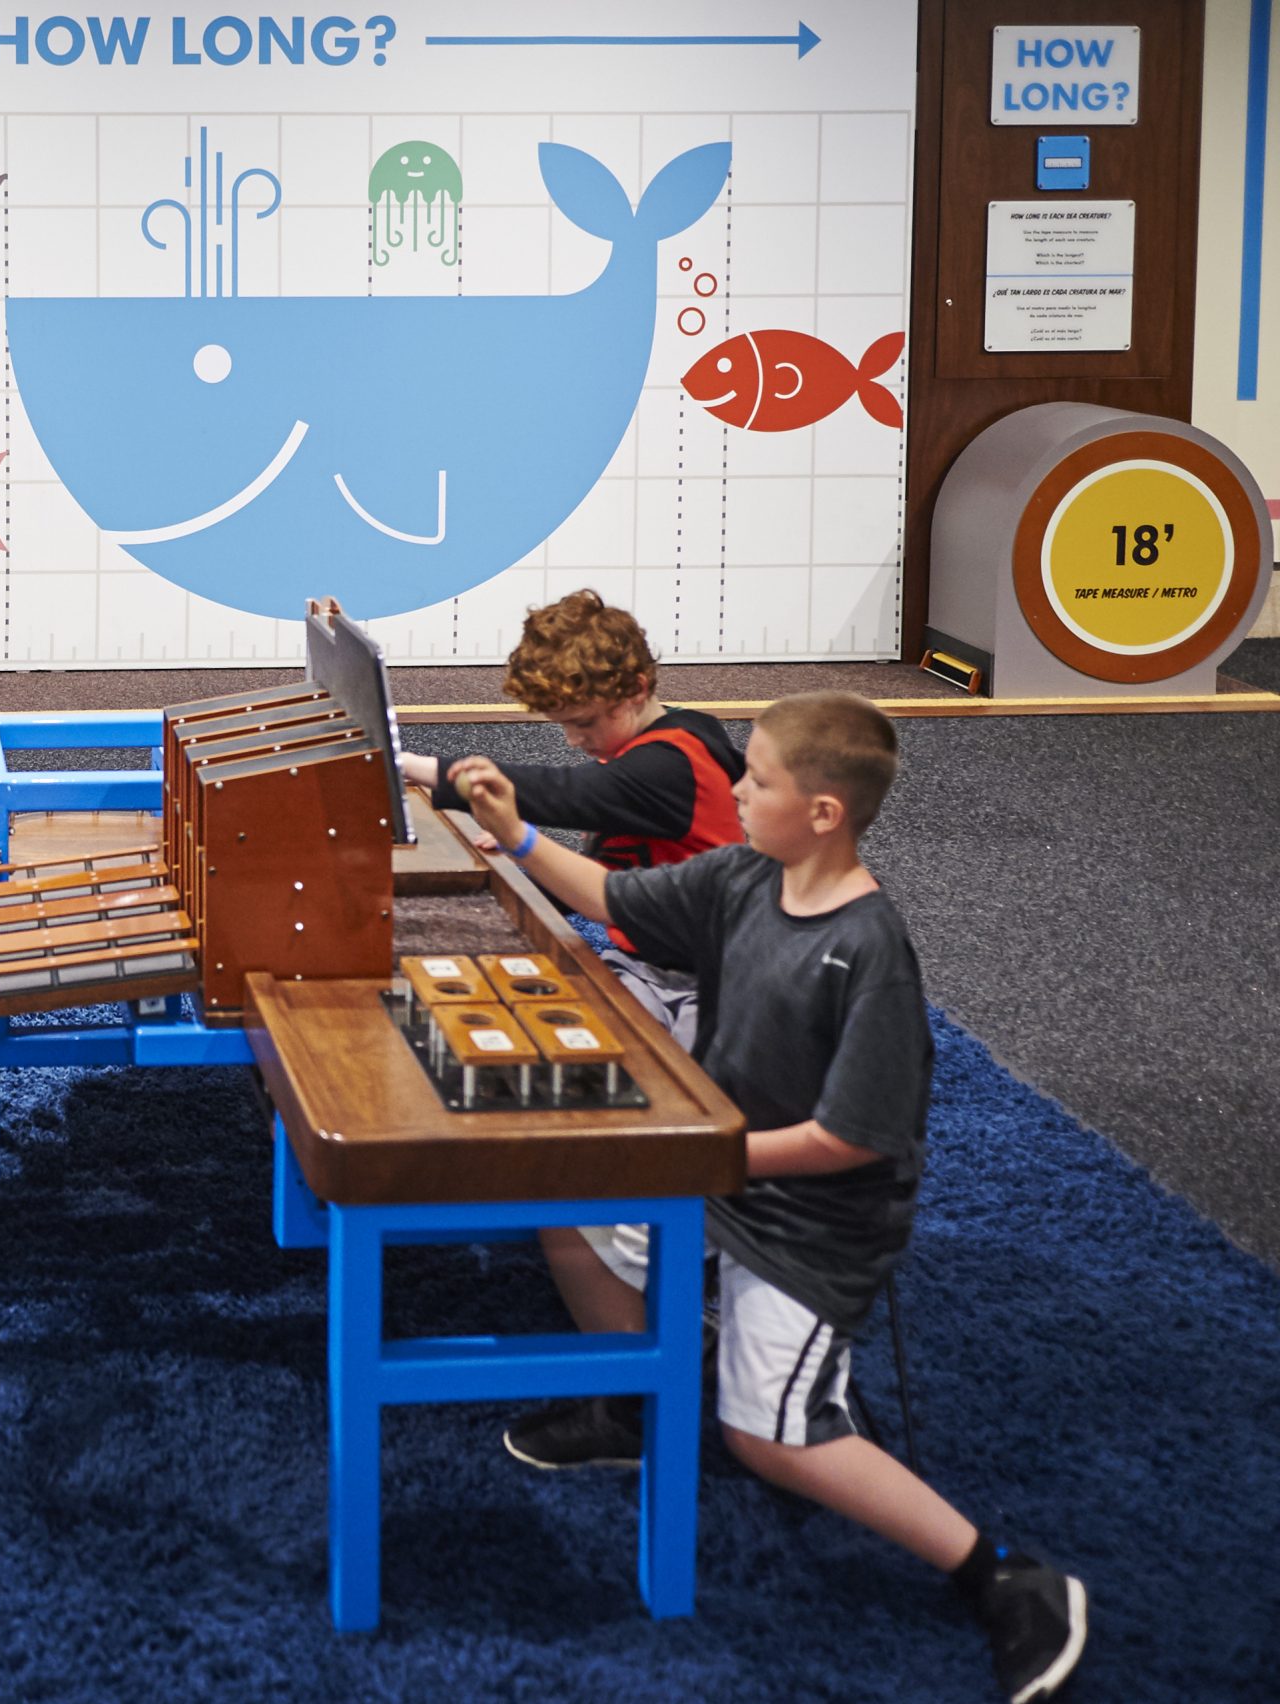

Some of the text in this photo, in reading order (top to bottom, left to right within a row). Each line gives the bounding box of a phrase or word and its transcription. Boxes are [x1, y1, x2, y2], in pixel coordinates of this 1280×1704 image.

[172, 14, 396, 67] LONG?
[1017, 38, 1114, 69] HOW
[1004, 81, 1130, 112] LONG?
[1010, 211, 1112, 221] HOW LONG IS EACH SEA CREATURE?
[992, 287, 1126, 299] ¿QUÉ TAN LARGO ES CADA CRIATURA DE MAR?
[1112, 523, 1174, 567] 18'
[1075, 586, 1197, 600] TAPE MEASURE / METRO
